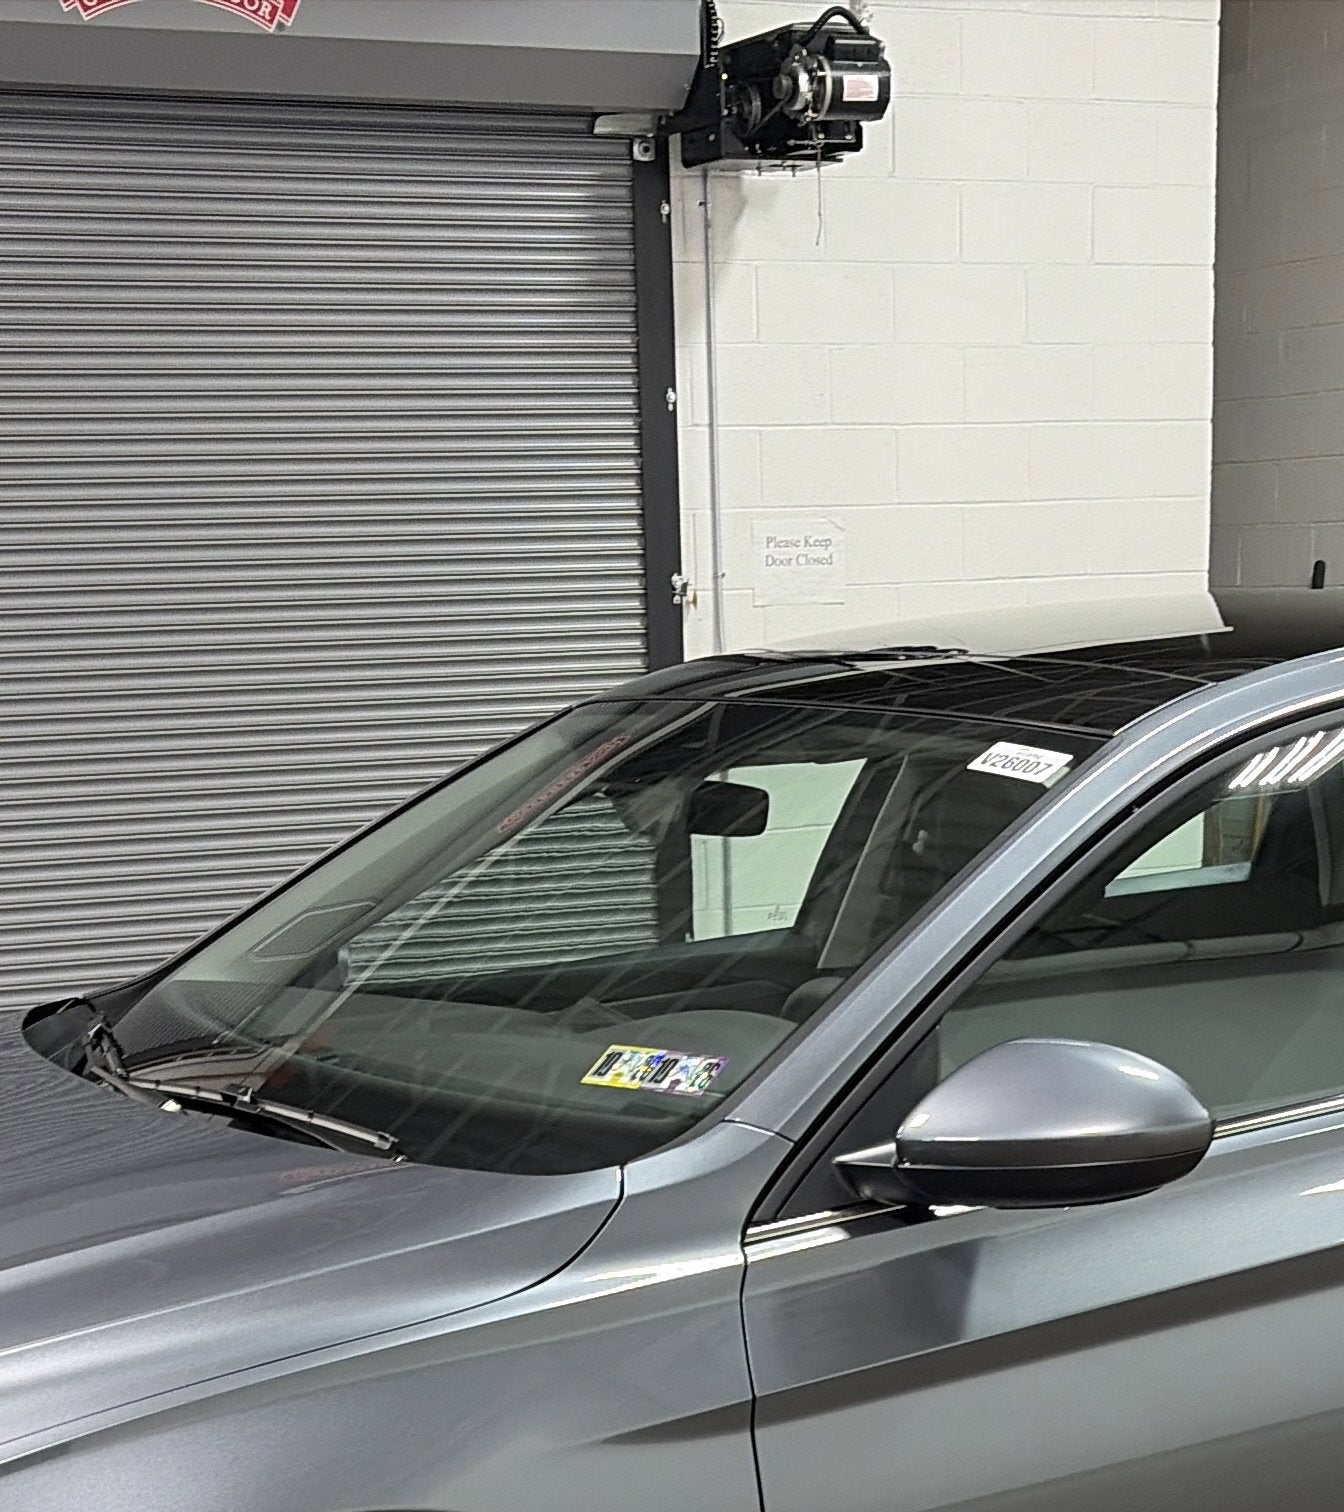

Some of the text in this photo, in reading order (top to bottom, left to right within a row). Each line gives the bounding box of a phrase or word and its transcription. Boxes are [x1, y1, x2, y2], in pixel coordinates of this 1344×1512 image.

[766, 535, 832, 550] Please Keep
[765, 553, 833, 567] Door Closed
[980, 752, 1053, 776] V26007
